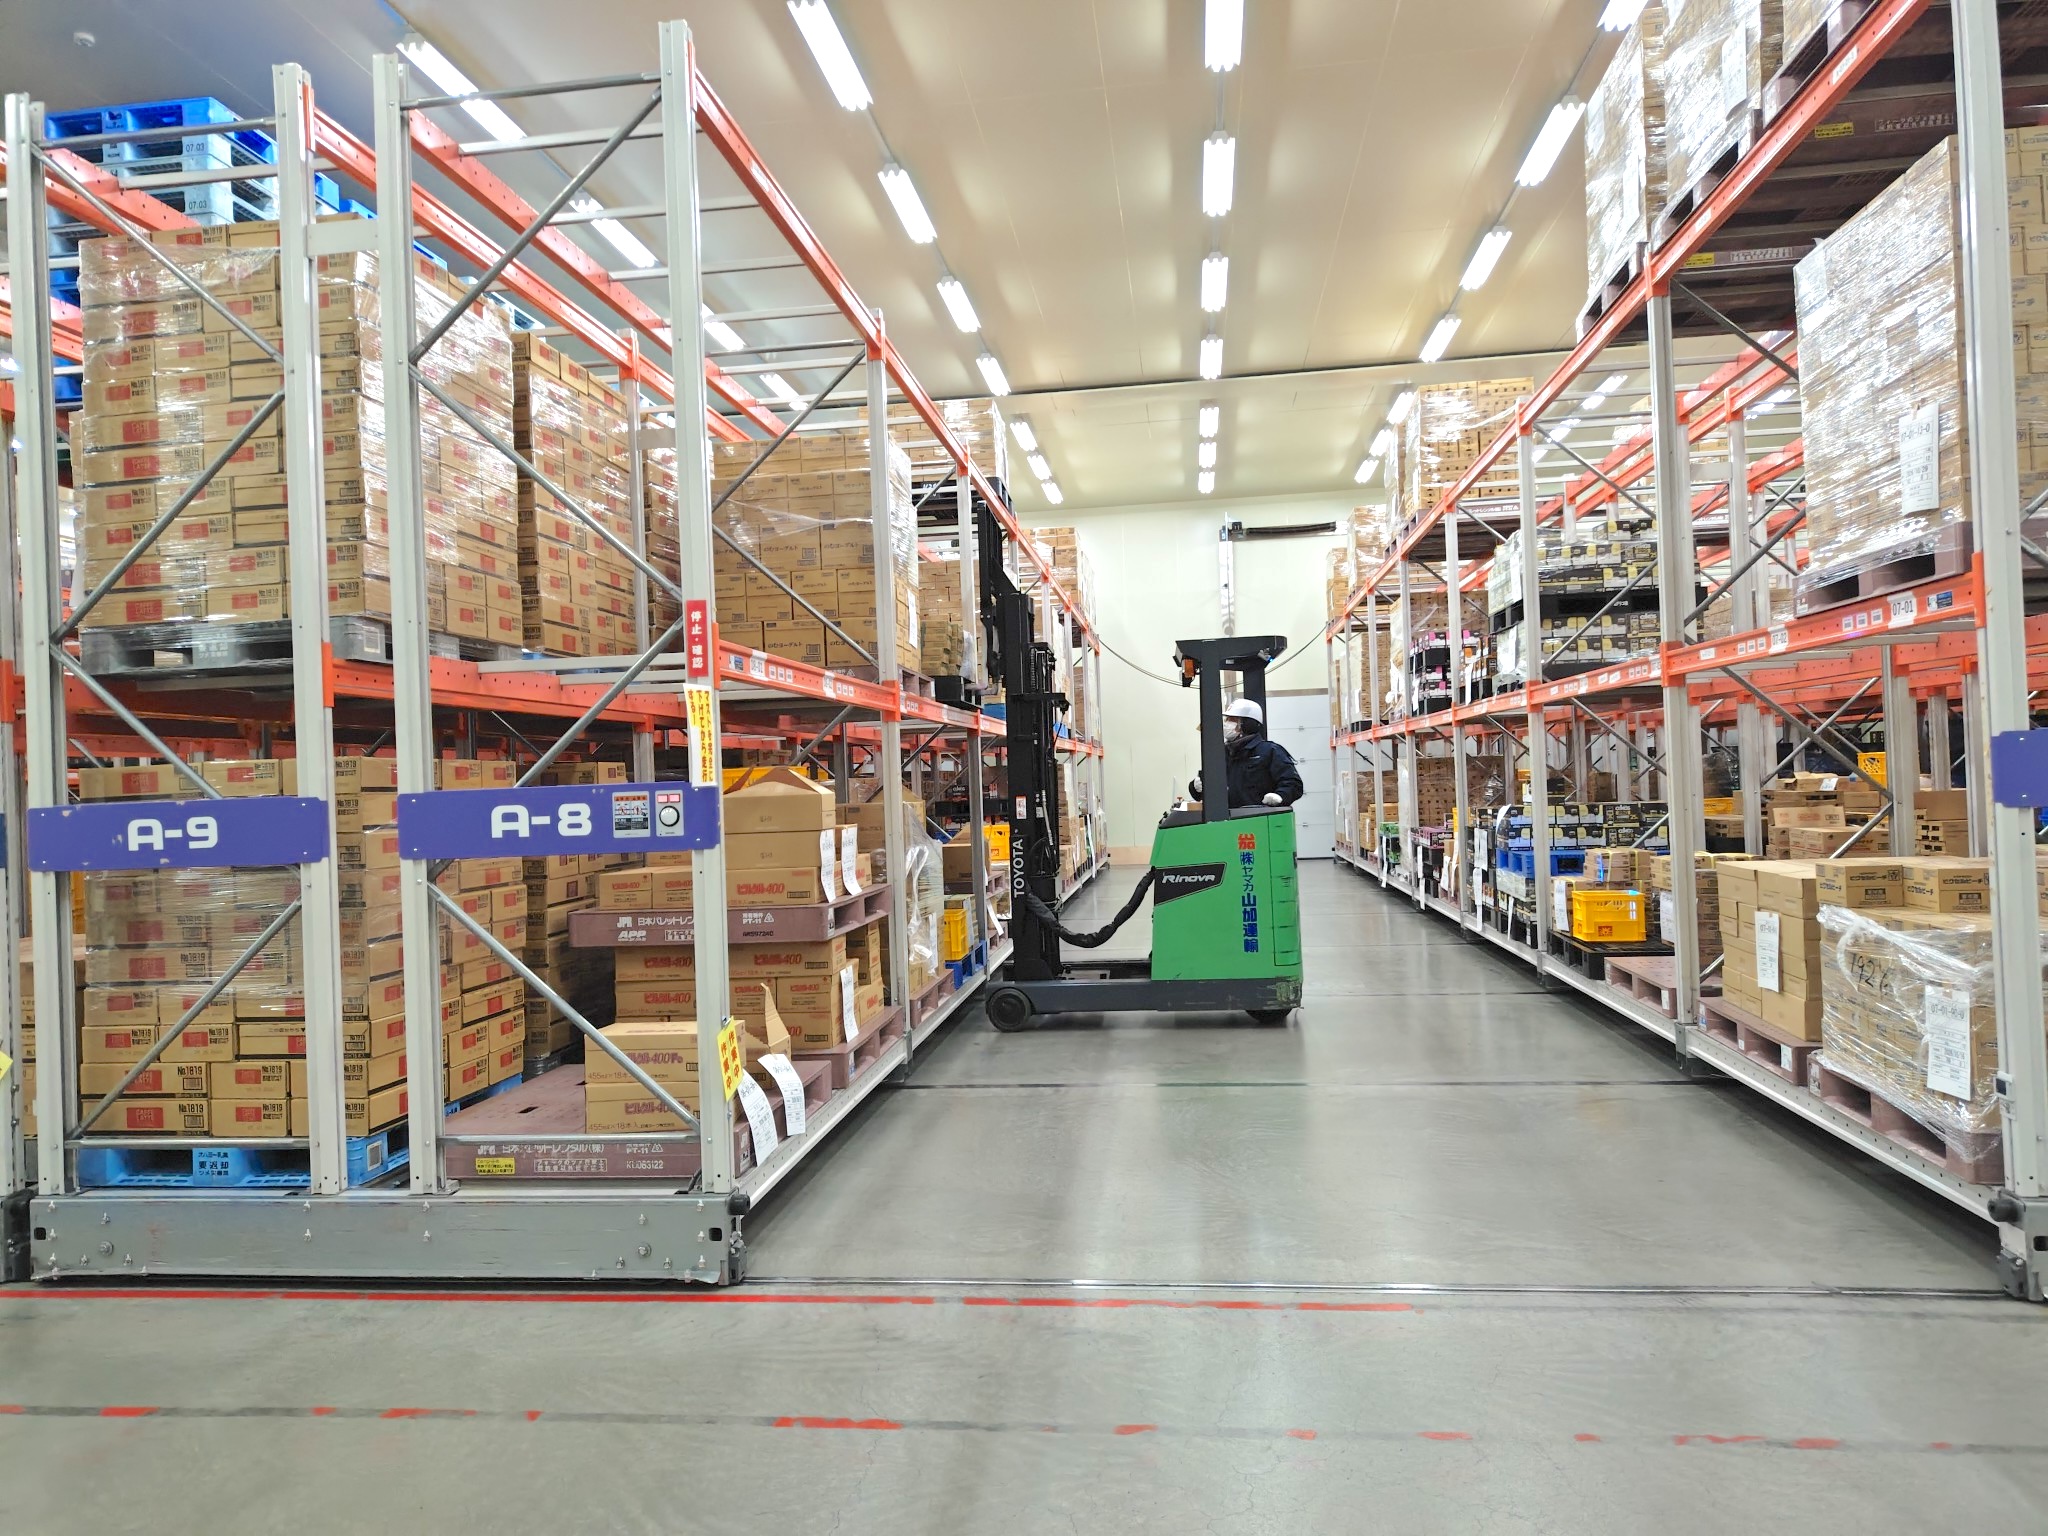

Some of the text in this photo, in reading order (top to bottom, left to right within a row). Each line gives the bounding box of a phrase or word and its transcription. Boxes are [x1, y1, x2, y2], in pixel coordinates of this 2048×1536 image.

[185, 142, 205, 152] 07.03
[188, 200, 207, 210] 07.03
[1892, 601, 1914, 617] 07-01
[690, 611, 703, 669] 停止・確認
[1771, 631, 1788, 647] 07-02
[491, 803, 592, 838] A-8
[127, 816, 218, 851] A-9
[1013, 839, 1025, 898] TOYOTA
[617, 916, 632, 928] JPR
[199, 1161, 229, 1170] 要返却
